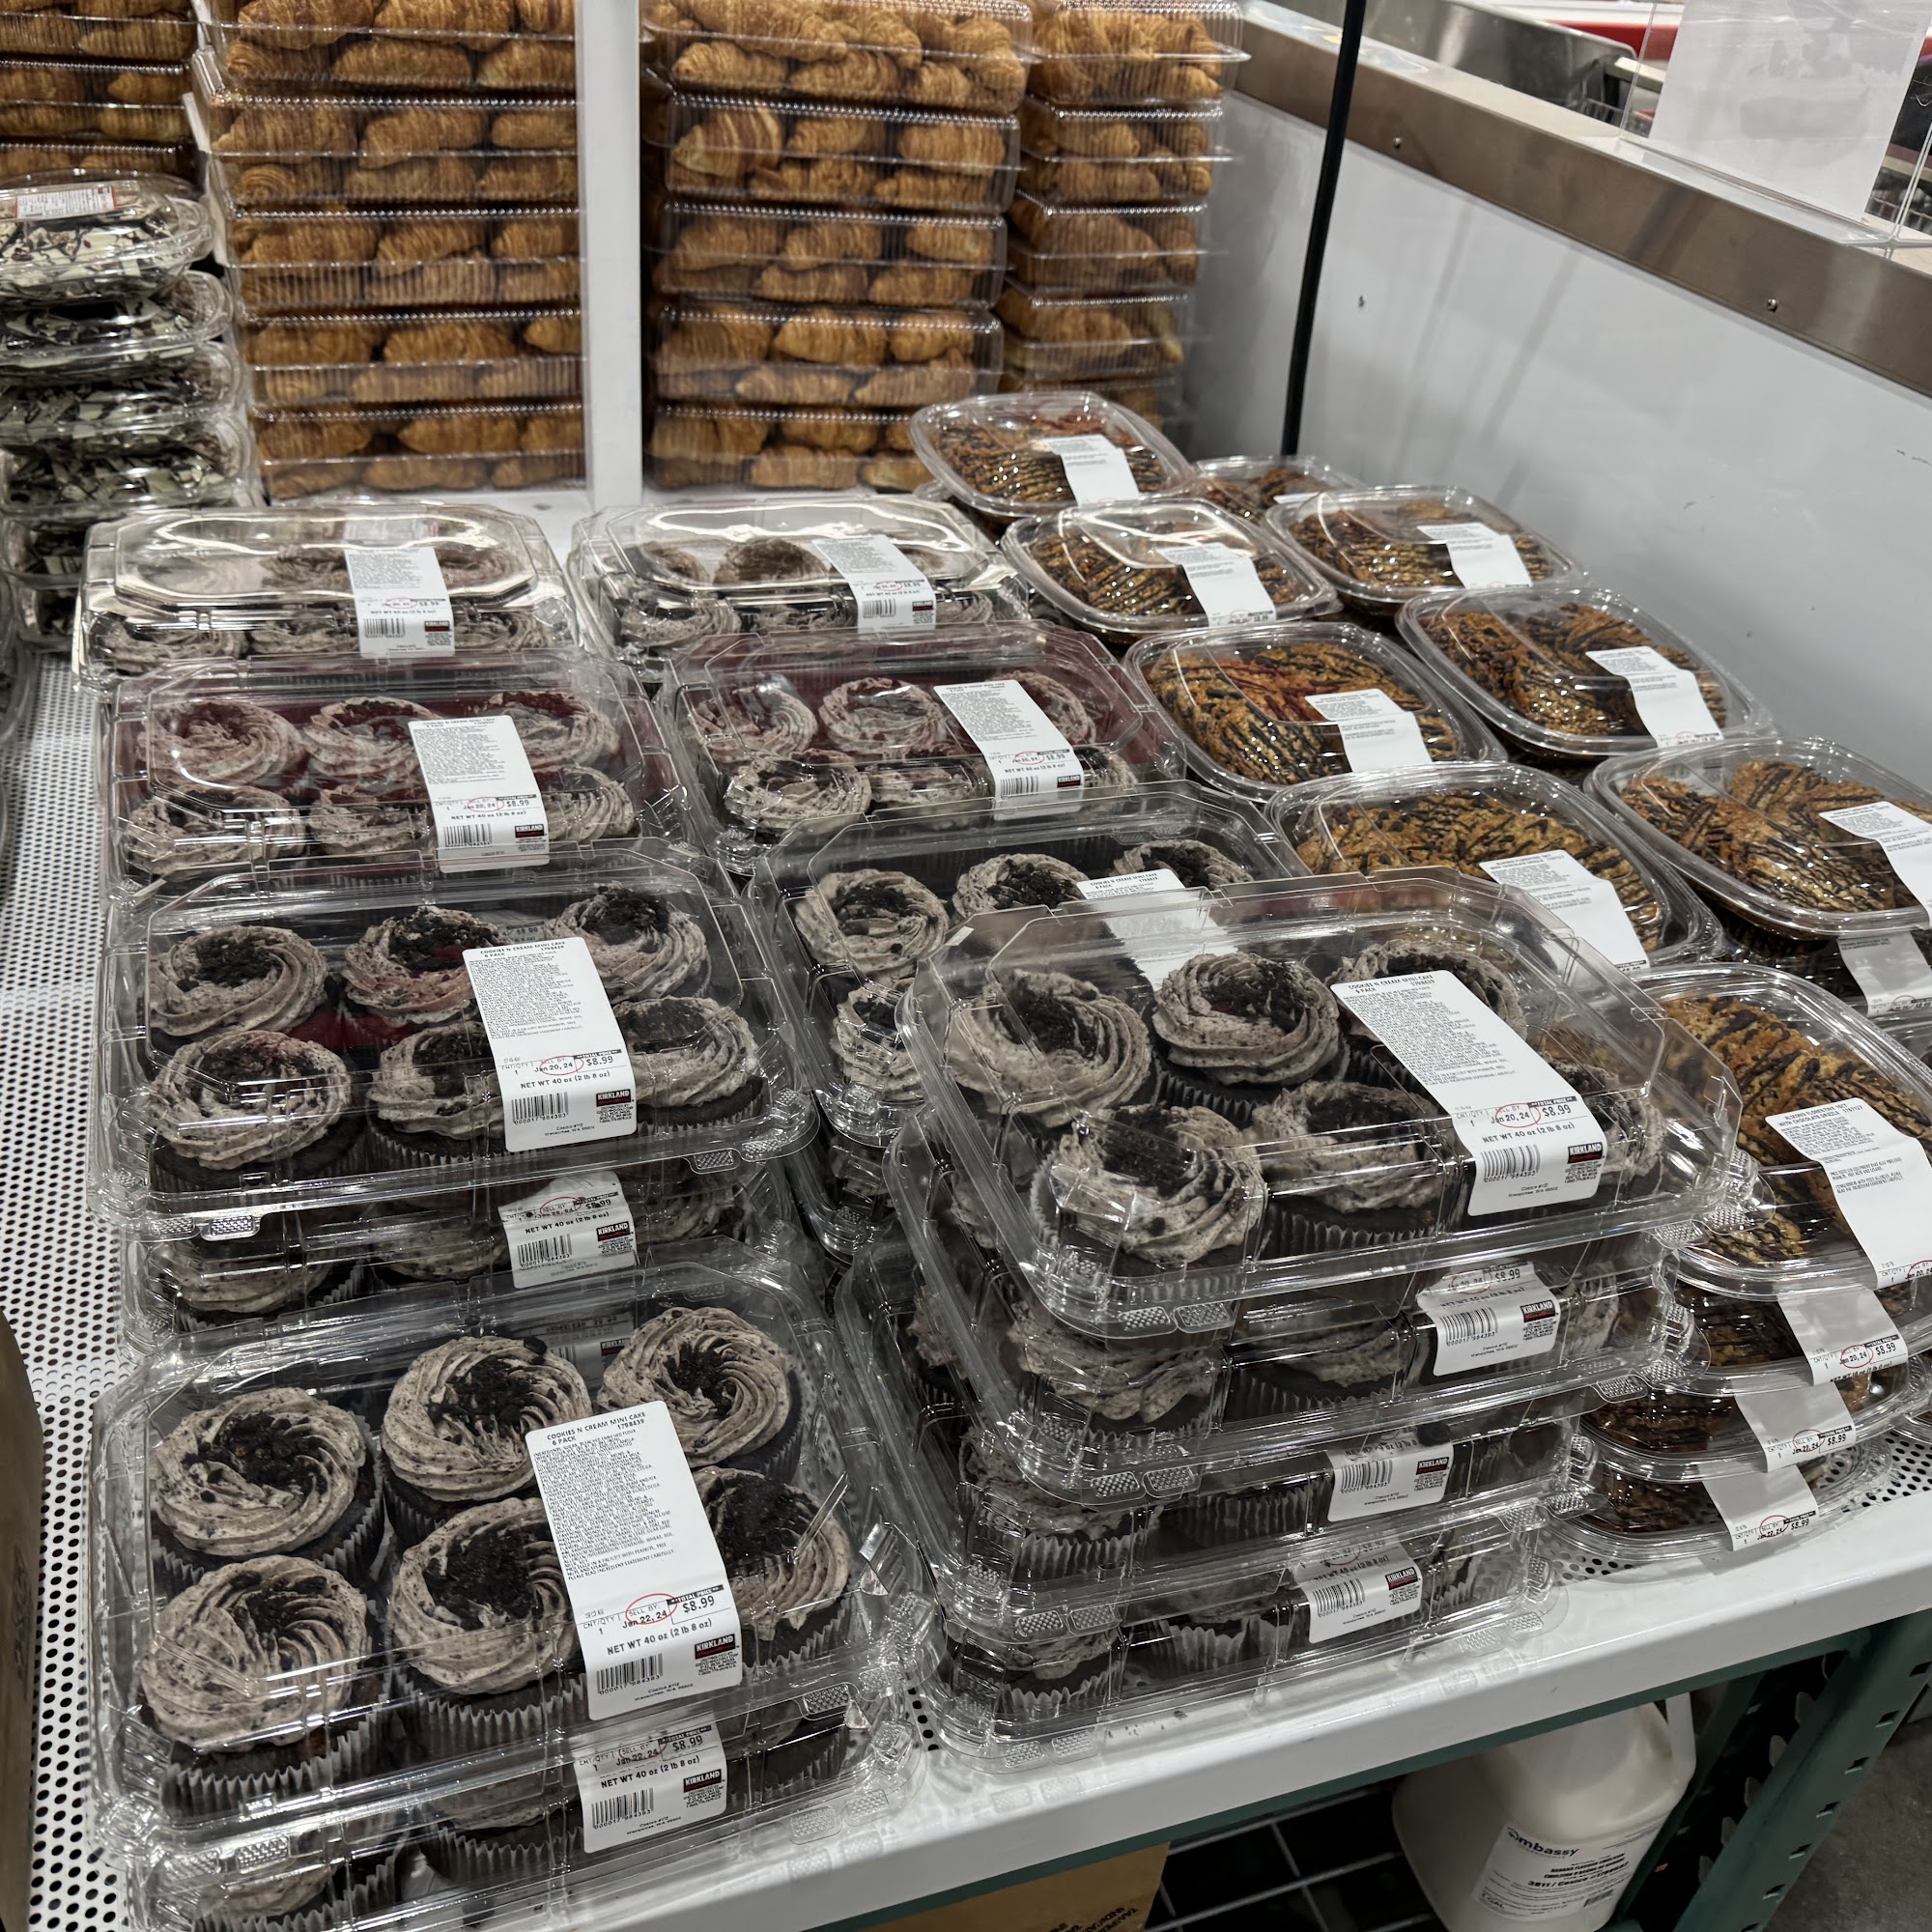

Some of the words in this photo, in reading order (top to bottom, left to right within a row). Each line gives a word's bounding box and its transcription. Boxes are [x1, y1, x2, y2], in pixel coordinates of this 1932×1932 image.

[586, 1056, 613, 1066] $8.99
[597, 1090, 630, 1100] KIRKLAND
[1542, 1104, 1572, 1118] $8.99
[1562, 1122, 1575, 1130] oz)
[1569, 1143, 1602, 1155] KIRKLAND
[598, 1222, 628, 1235] KIRKLAND
[1522, 1301, 1553, 1314] KIRKLAND
[1876, 1342, 1896, 1355] $8.99
[547, 1430, 576, 1440] COOKIES
[585, 1421, 609, 1432] CREAM
[610, 1416, 628, 1425] MINI
[629, 1411, 646, 1421] CAKE
[558, 1435, 577, 1444] PACK
[617, 1419, 645, 1430] 1798439
[1828, 1434, 1846, 1446] $8.99
[1419, 1458, 1448, 1468] KIRKLAND
[1388, 1569, 1415, 1582] KIRKLAND
[677, 1593, 695, 1604] TOTAL
[696, 1587, 712, 1596] PRICE
[582, 1615, 615, 1630] CNT/QTY
[629, 1607, 644, 1618] SELL
[648, 1604, 661, 1612] BY:
[622, 1620, 639, 1629] Jan
[639, 1614, 655, 1625] 22,
[656, 1609, 668, 1620] 24
[682, 1596, 715, 1613] $8.99
[607, 1645, 625, 1656] NET
[627, 1639, 641, 1650] WT
[643, 1634, 656, 1644] 40
[669, 1628, 680, 1638] (2
[681, 1625, 690, 1634] lb
[692, 1622, 697, 1631] 8
[698, 1618, 712, 1631] oz)
[696, 1635, 734, 1652] KIRKLAND
[616, 1757, 631, 1766] Jan
[648, 1748, 658, 1757] 24
[672, 1735, 703, 1752] $8.99
[601, 1778, 618, 1788] NET
[621, 1774, 633, 1783] WT
[660, 1764, 669, 1774] (2
[670, 1760, 678, 1769] lb
[688, 1755, 699, 1765] oz)
[685, 1771, 721, 1786] KIRKLAND
